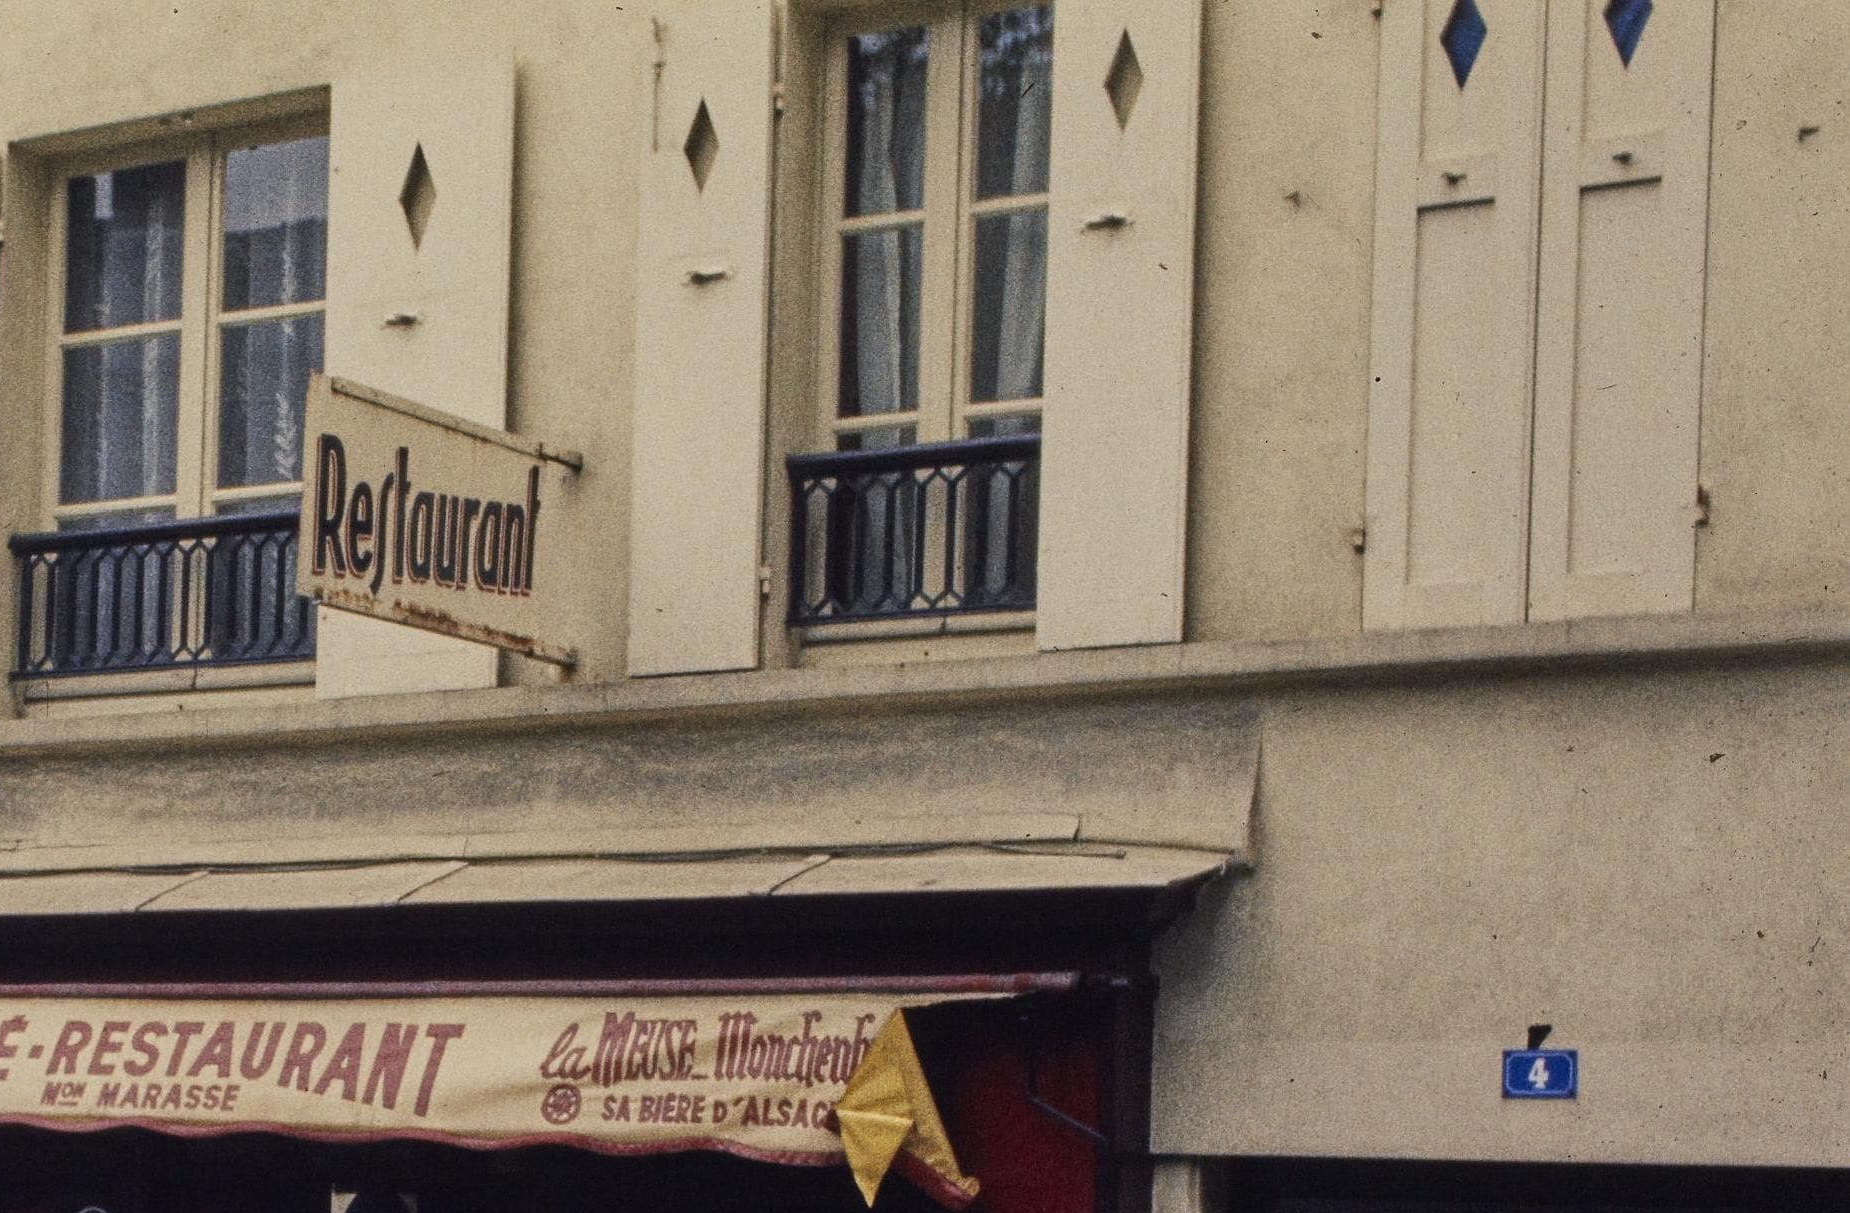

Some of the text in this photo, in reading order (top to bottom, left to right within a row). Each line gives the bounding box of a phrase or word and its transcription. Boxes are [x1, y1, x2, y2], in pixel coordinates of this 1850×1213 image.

[312, 432, 541, 597] Restaurant
[1527, 1056, 1550, 1090] 4
[96, 1082, 241, 1112] MARASSE
[602, 1094, 631, 1122] SA
[712, 1096, 839, 1130] D'ALSAC
